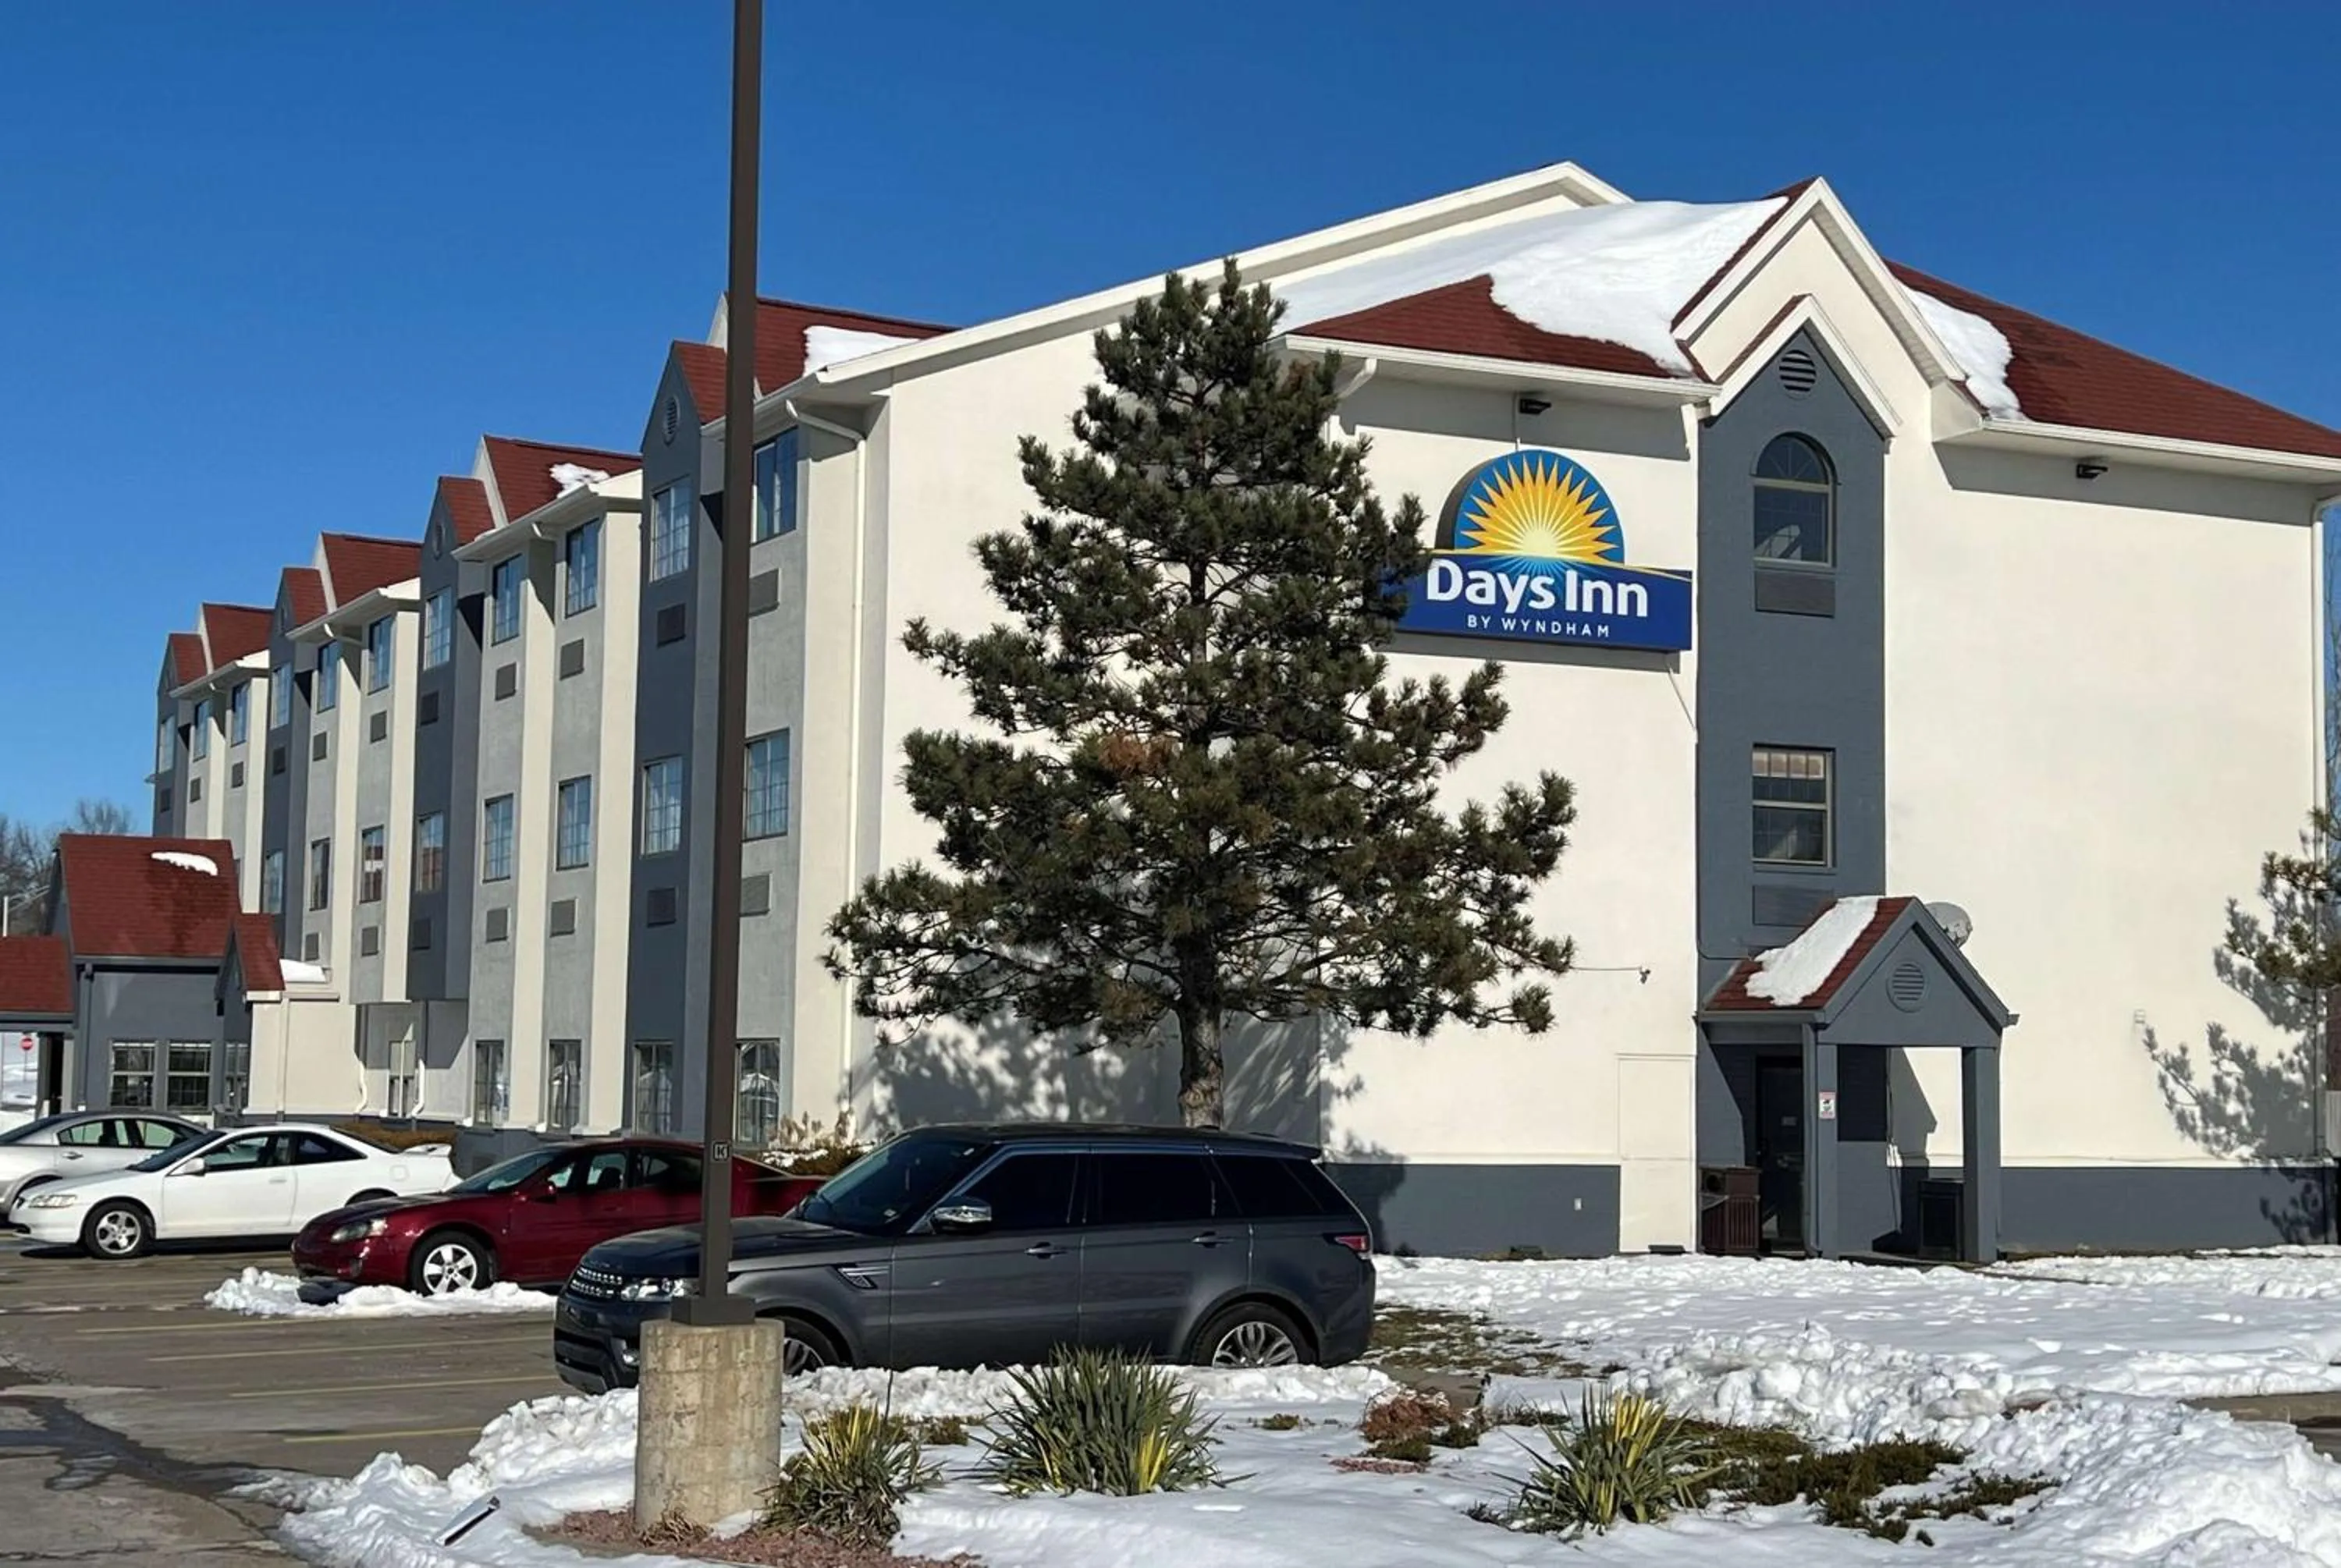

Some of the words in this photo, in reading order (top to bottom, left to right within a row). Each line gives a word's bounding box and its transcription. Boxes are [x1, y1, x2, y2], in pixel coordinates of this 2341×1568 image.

[1426, 559, 1555, 614] Days
[1565, 569, 1648, 617] Inn
[1467, 614, 1491, 628] BY
[1501, 618, 1609, 637] WYNDHAM
